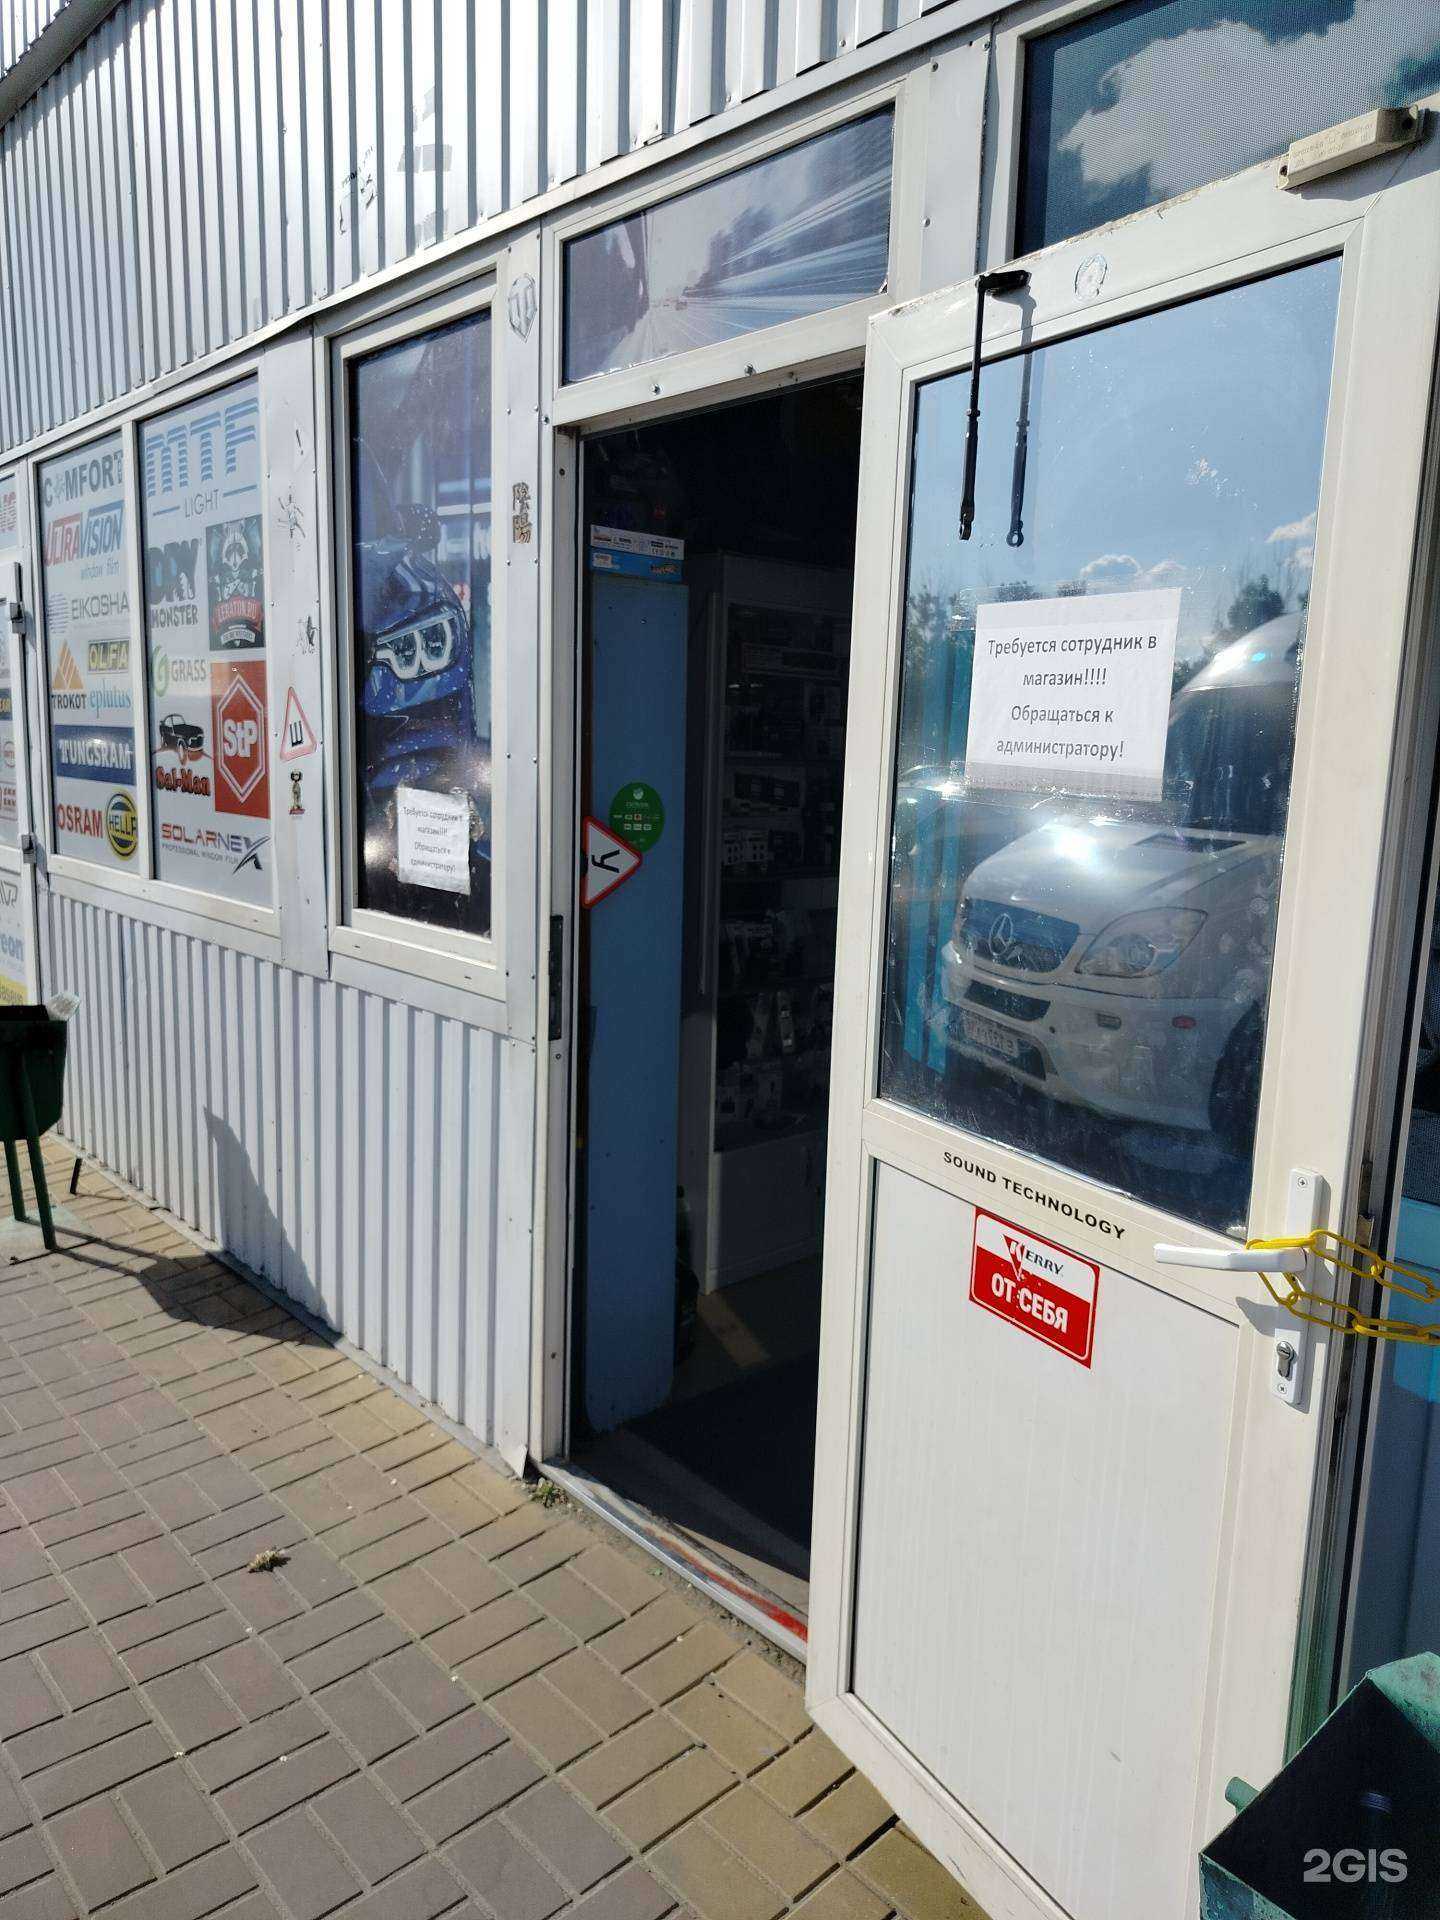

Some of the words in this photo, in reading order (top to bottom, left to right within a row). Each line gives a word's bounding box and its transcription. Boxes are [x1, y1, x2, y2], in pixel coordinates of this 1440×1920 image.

[185, 489, 219, 518] LIGHT
[71, 591, 130, 620] EIKOSHA
[149, 604, 198, 628] MONSTER
[988, 637, 1056, 658] Требуется
[1061, 635, 1143, 655] сотрудник
[171, 659, 207, 681] GRASS
[1023, 668, 1107, 686] магазин!!!!
[51, 693, 87, 710] TROKOT
[1011, 704, 1100, 726] Обращаться
[1105, 710, 1114, 723] к
[60, 738, 132, 769] TUNGSRAM
[996, 739, 1124, 761] администратору!
[56, 803, 104, 838] OSRAM
[162, 823, 271, 875] SOLARNEX
[943, 1151, 996, 1183] SOUND
[1002, 1177, 1126, 1240] TECHNOLOGY
[991, 1272, 1016, 1302] ОТ
[1018, 1288, 1069, 1333] СЕБЯ
